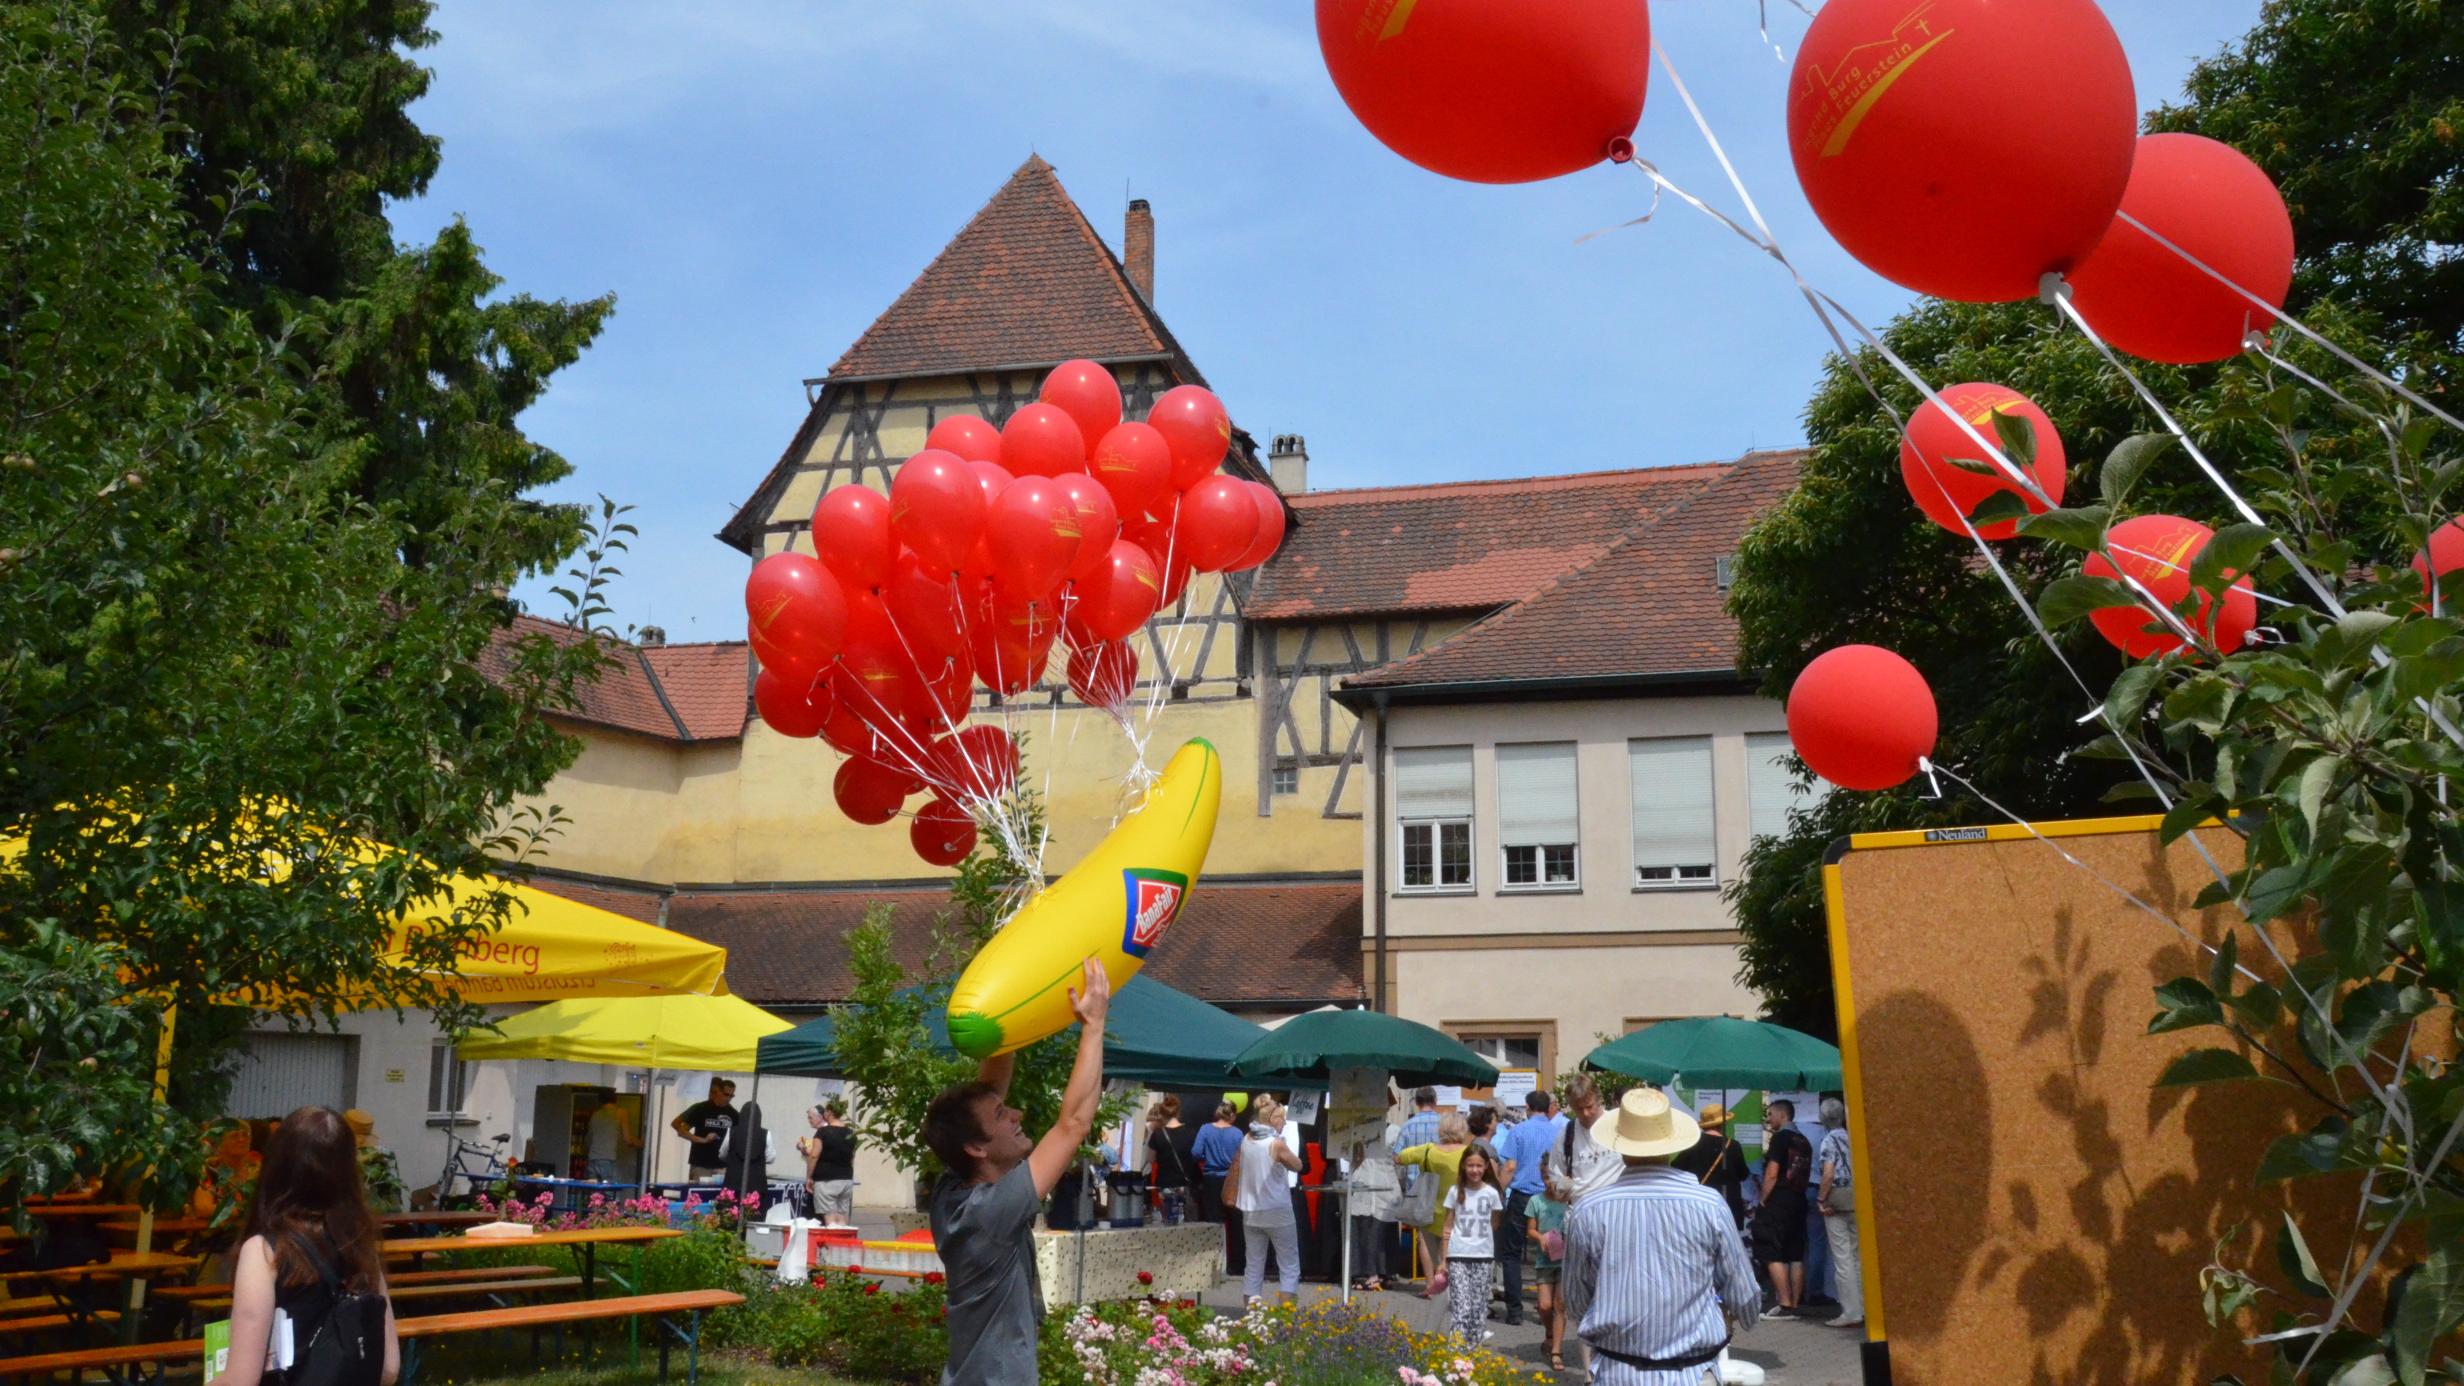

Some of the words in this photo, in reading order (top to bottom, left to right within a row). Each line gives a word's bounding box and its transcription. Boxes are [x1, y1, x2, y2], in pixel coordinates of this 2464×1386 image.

[1828, 66, 1862, 100] Burg
[1836, 42, 1912, 113] Feuerstein
[1938, 830, 1985, 841] Neuland
